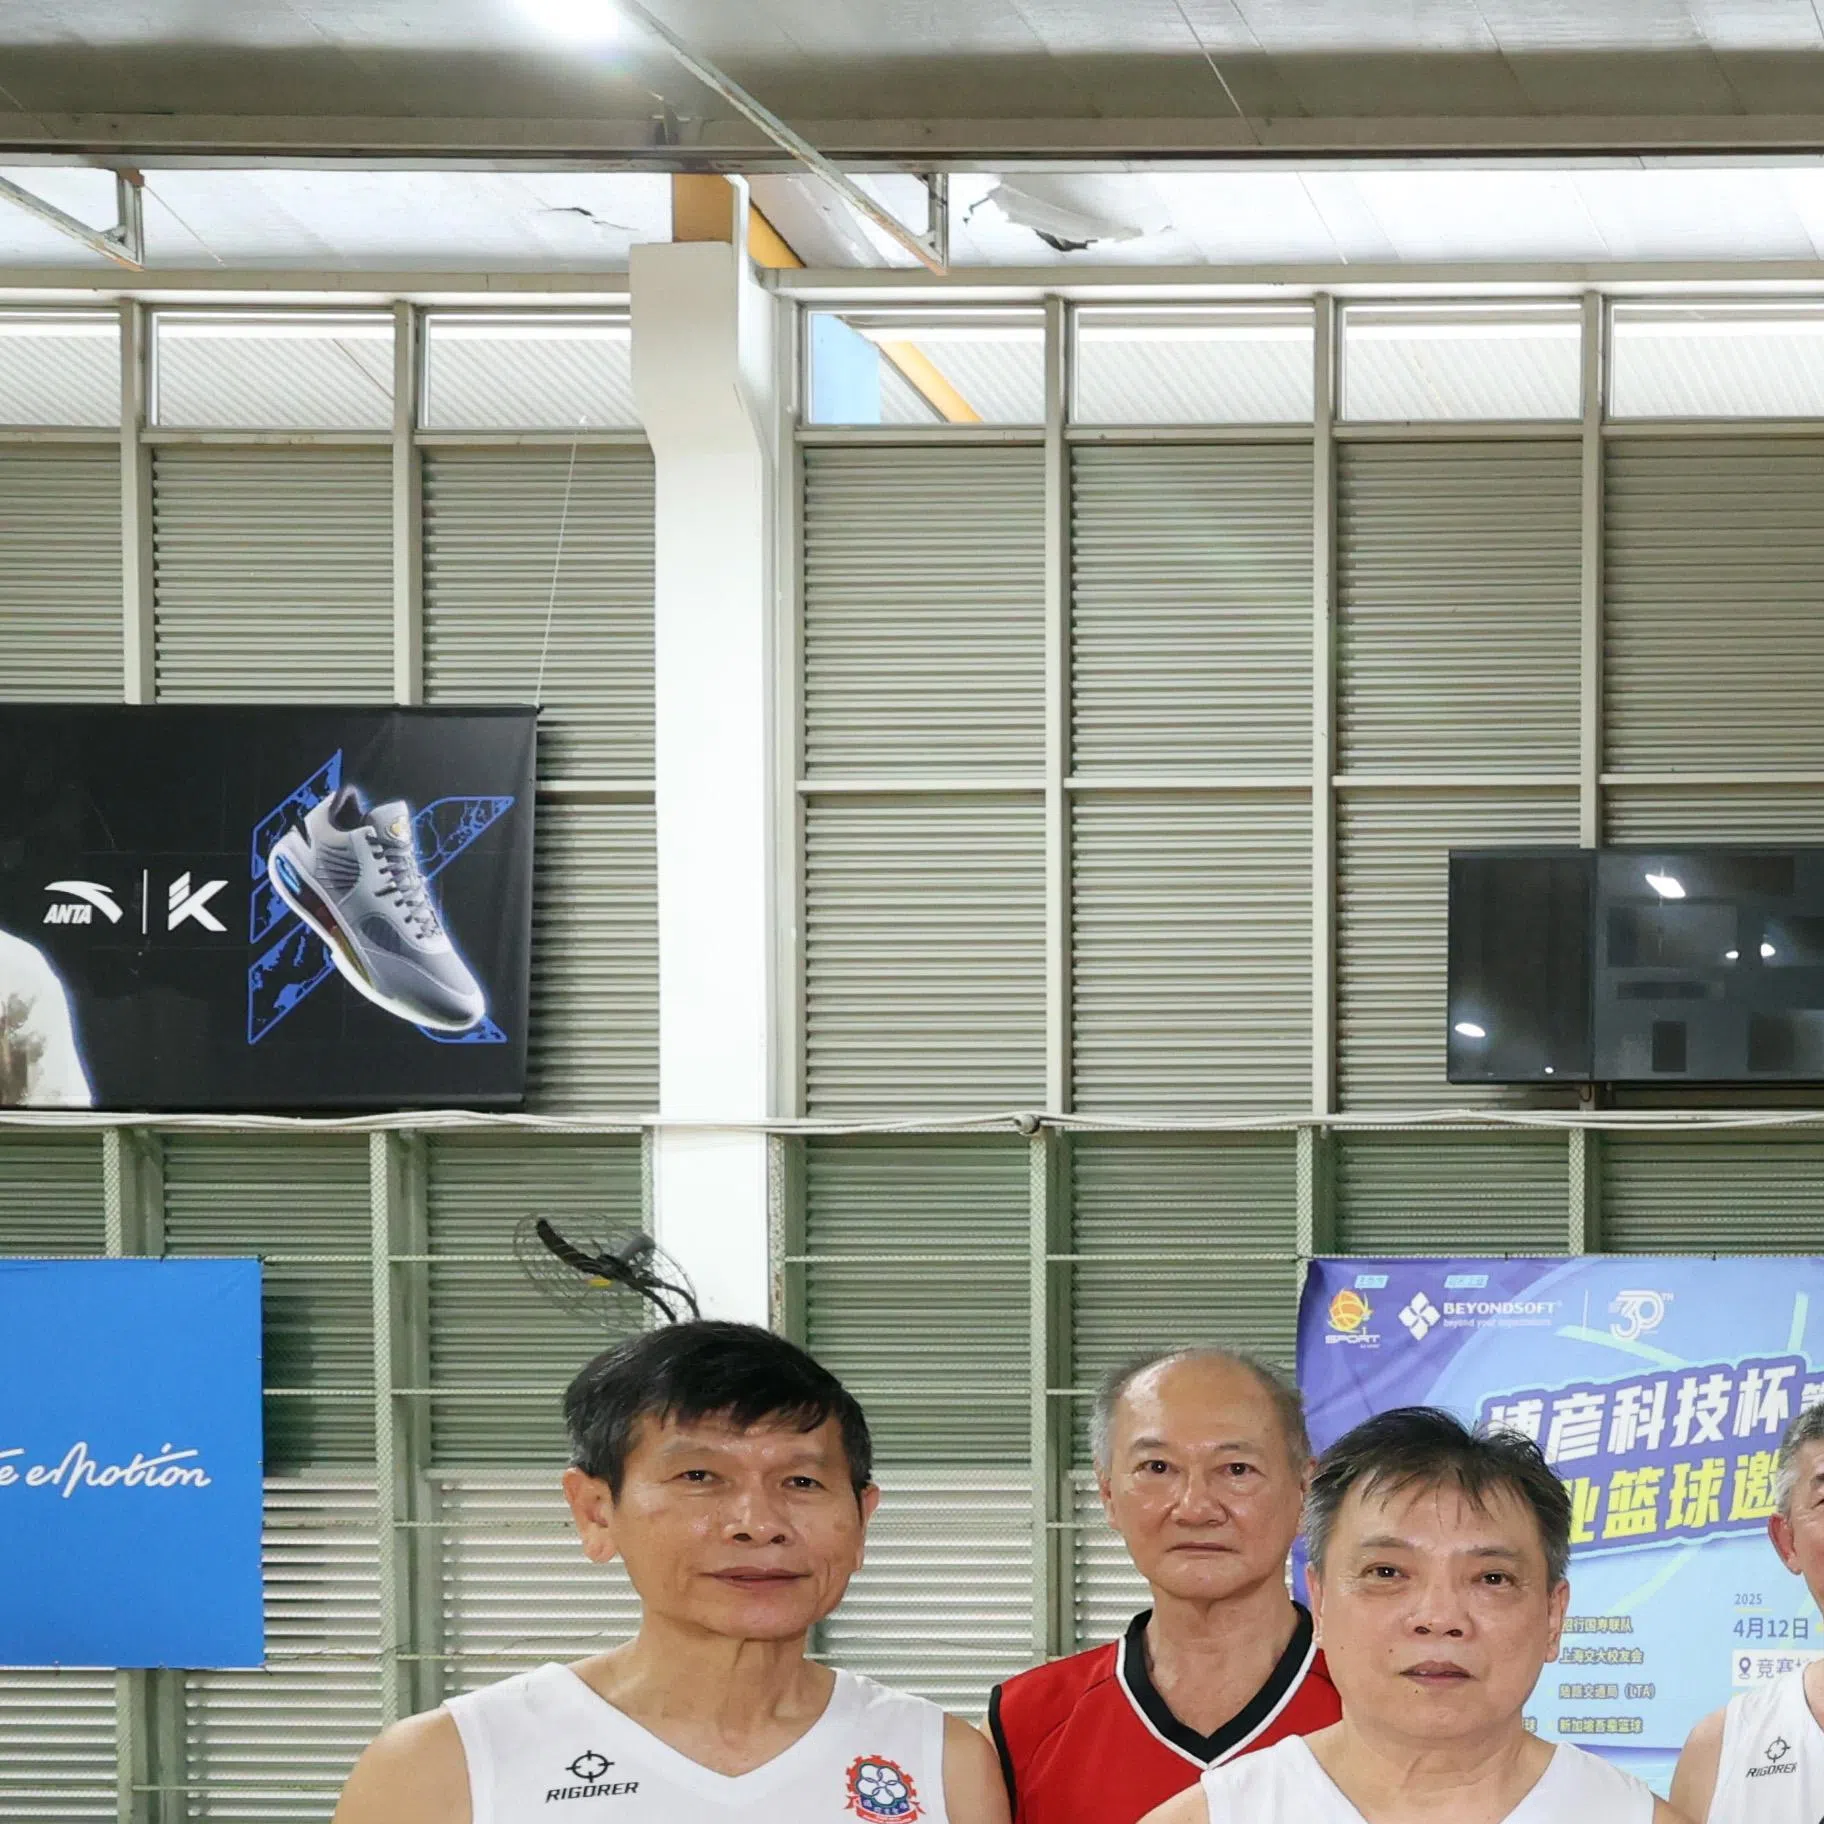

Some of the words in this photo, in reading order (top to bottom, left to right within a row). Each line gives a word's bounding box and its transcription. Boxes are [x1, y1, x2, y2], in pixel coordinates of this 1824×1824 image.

[43, 903, 93, 925] ANTA
[1443, 1301, 1556, 1316] BEYONDSOFT
[1734, 1593, 1763, 1606] 2025
[1733, 1617, 1810, 1640] 4月12日
[545, 1781, 640, 1804] RIGORER
